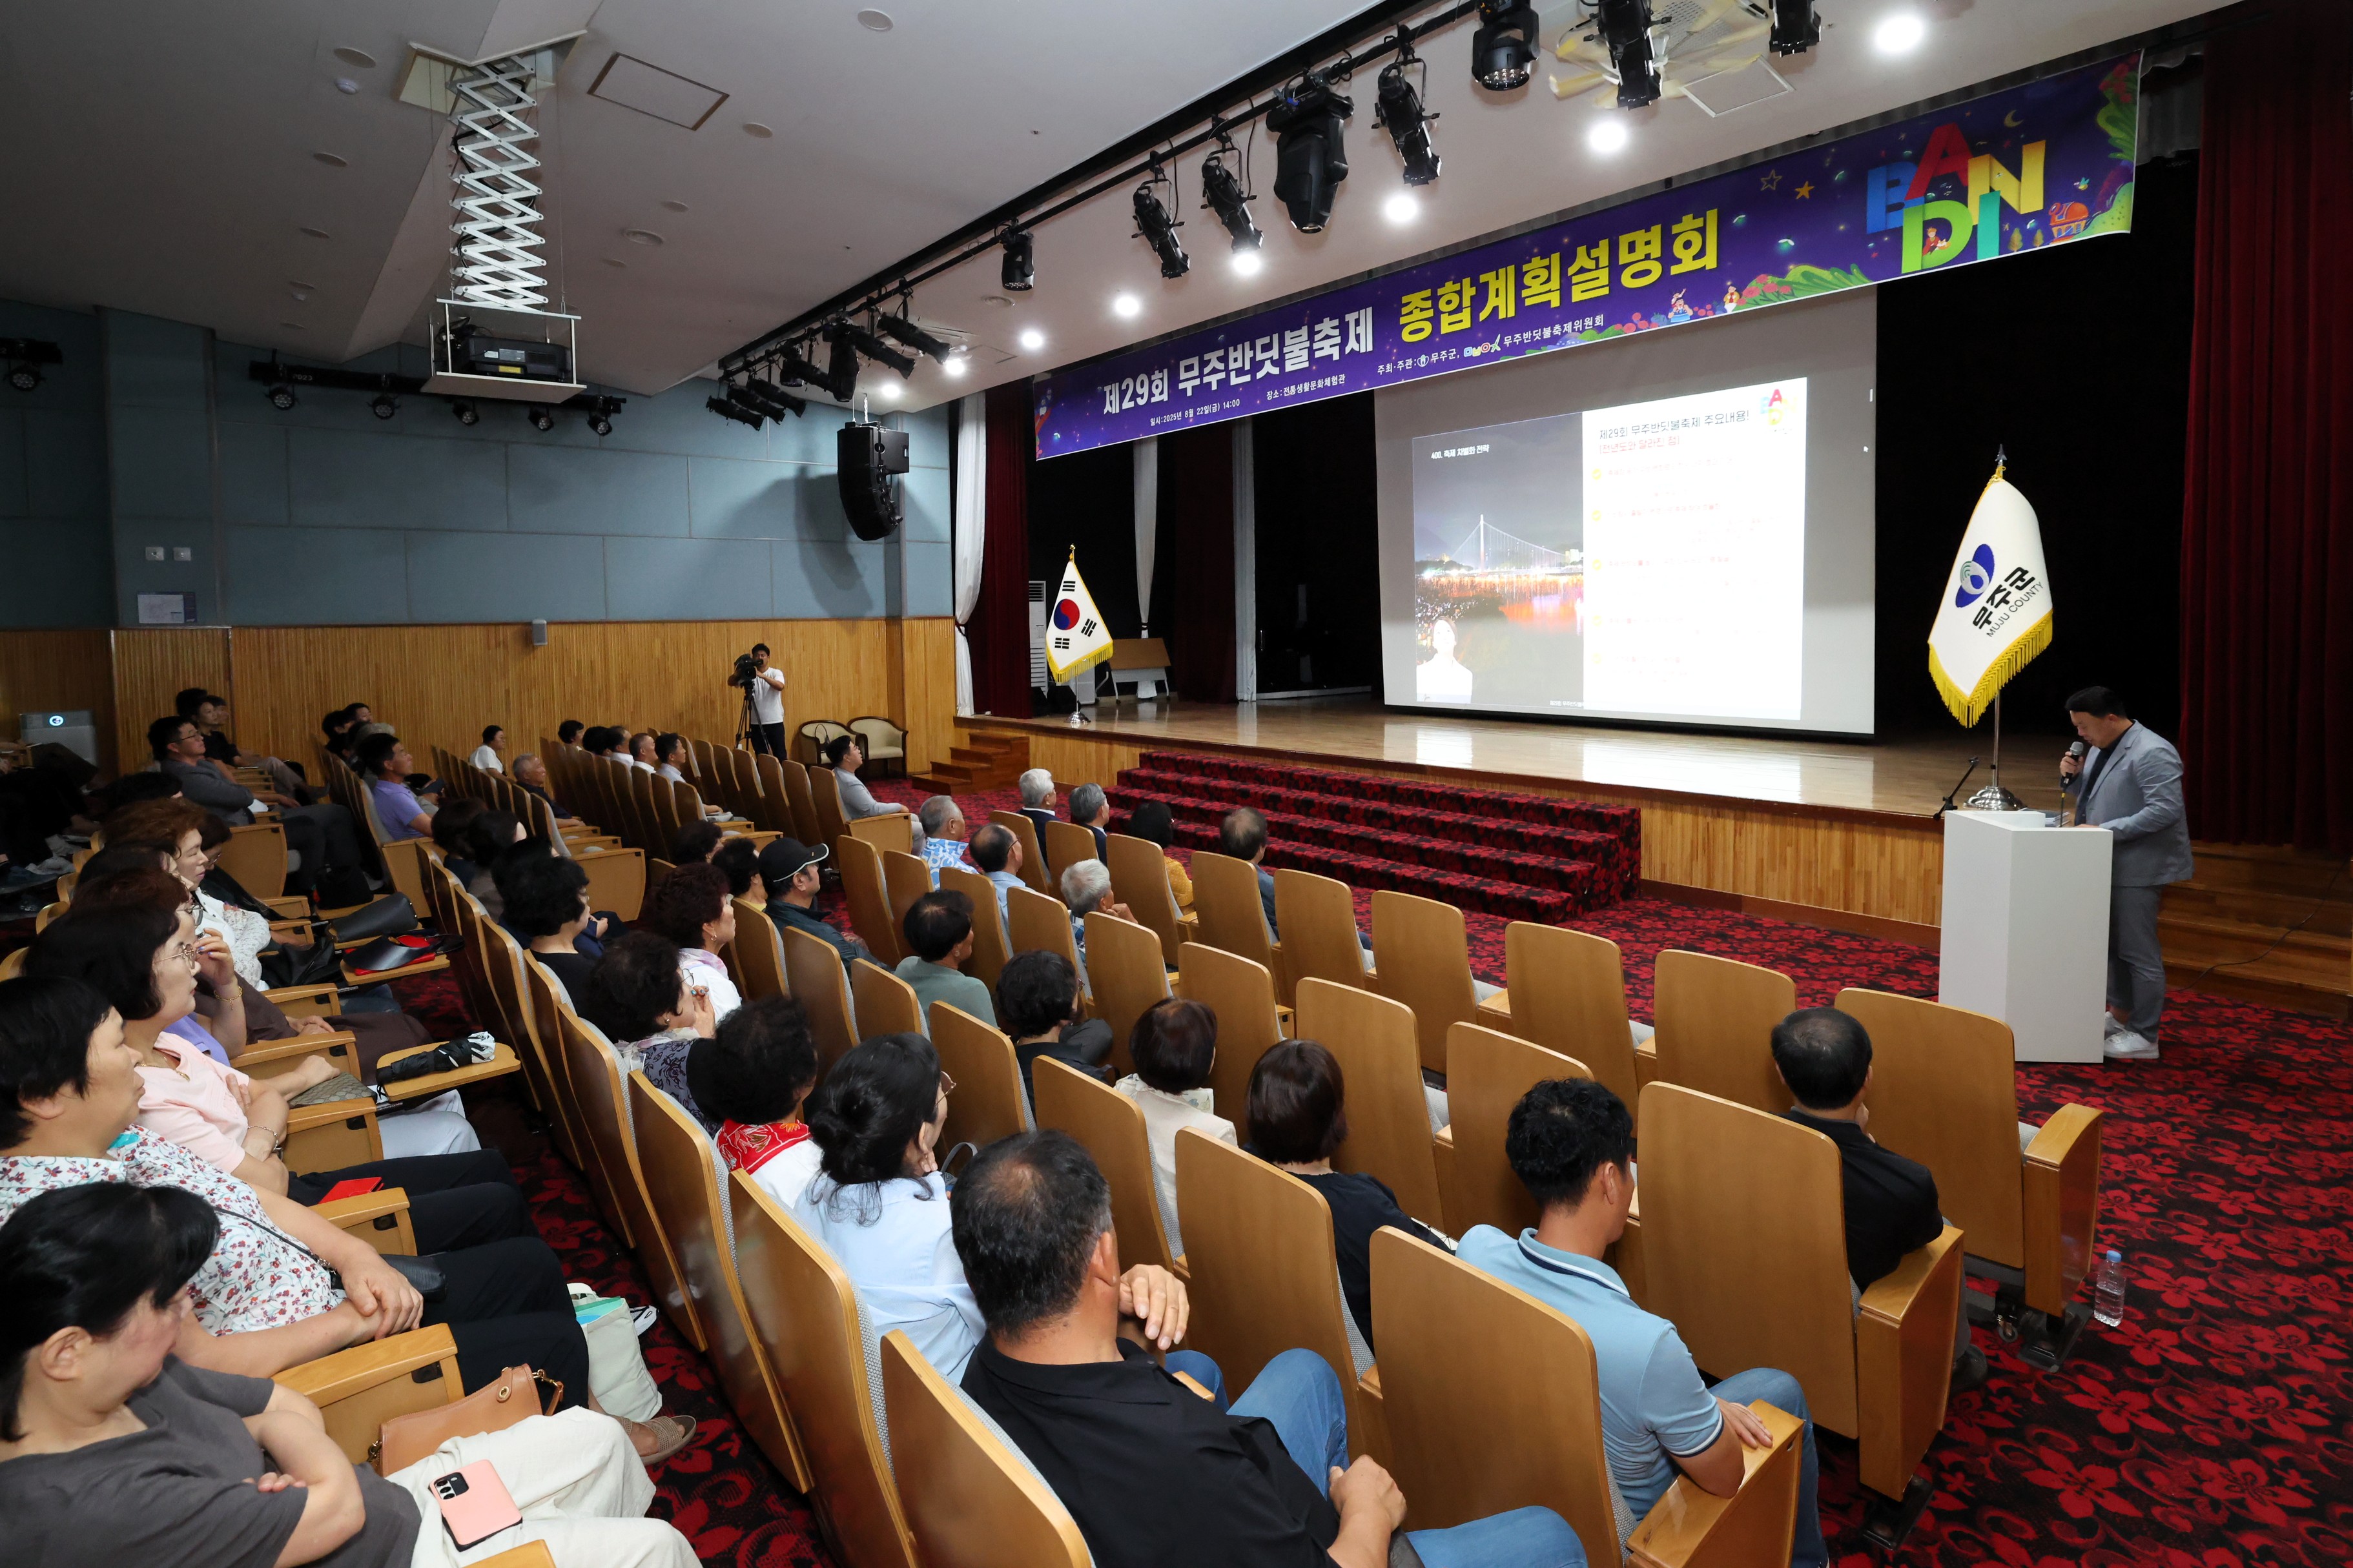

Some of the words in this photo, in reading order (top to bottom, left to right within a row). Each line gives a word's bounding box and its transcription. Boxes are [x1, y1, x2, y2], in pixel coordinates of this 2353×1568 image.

[1104, 368, 1169, 415] 제29회
[1178, 306, 1373, 396] 무주반딧불축제
[1399, 208, 1719, 343] 종합계획설명회
[1503, 314, 1604, 347] 무주반딧불축제위원회
[1184, 408, 1194, 418] 8월
[1197, 402, 1220, 415] 22일(금)
[1223, 398, 1240, 409] 14:00
[1599, 427, 1628, 440] 제29회
[1632, 417, 1700, 436] 무주반딧불축제
[1704, 410, 1749, 426] 주요내용!
[1973, 567, 2036, 630] 무주군
[1986, 612, 2010, 638] MUJU
[2008, 582, 2044, 613] COUNTY
